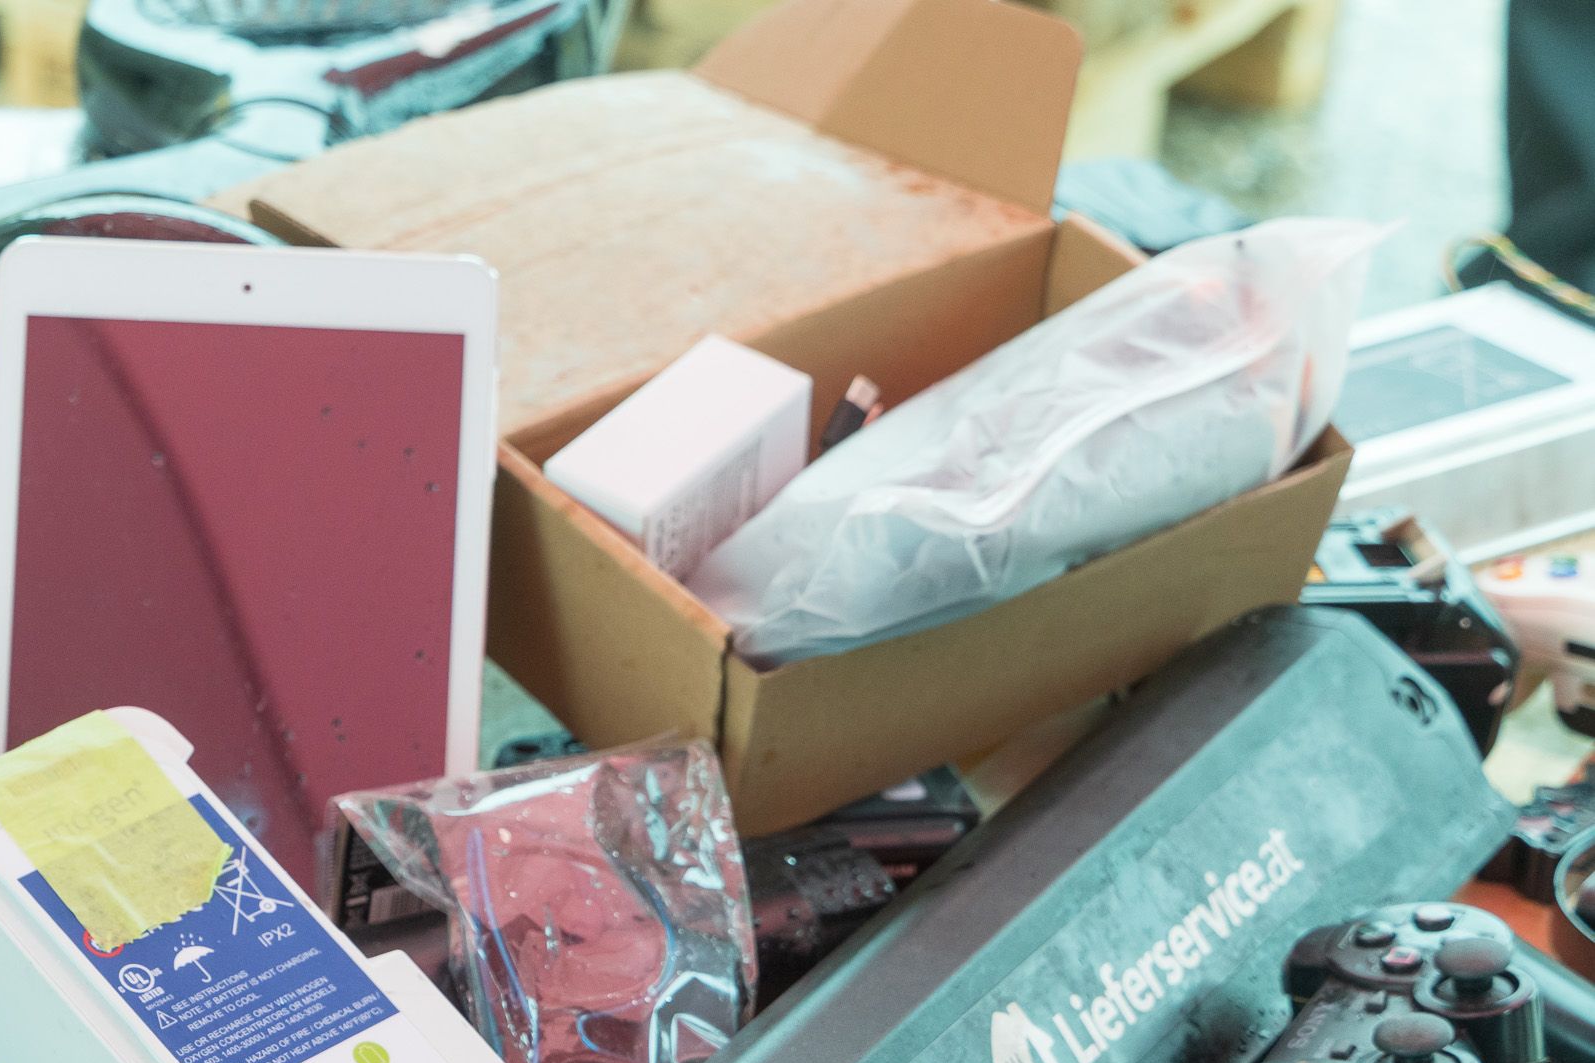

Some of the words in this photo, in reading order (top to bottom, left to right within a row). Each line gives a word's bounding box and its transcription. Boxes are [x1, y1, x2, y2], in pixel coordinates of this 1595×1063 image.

[257, 922, 296, 947] IPX2
[169, 999, 190, 1013] SEE
[187, 969, 250, 1004] INSTRUCTIONS
[202, 999, 215, 1009] IF
[211, 982, 250, 1004] BATTERY
[247, 977, 260, 986] IS
[257, 968, 277, 982] NOT
[174, 1042, 195, 1056] USE
[192, 1035, 210, 1048] OR
[206, 1013, 254, 1040] RECHARGE
[251, 1002, 276, 1018] ONLY
[272, 991, 298, 1007] WITH
[295, 975, 329, 996] INOGEN
[186, 1009, 224, 1031] REMOVE
[221, 1003, 237, 1014] TO
[216, 1007, 291, 1048] CONCENTRATORS
[287, 1000, 304, 1012] OR
[301, 983, 337, 1005] MODELS
[265, 1021, 286, 1035] AND
[277, 1036, 293, 1048] OF
[289, 1026, 312, 1041] FIRE
[312, 1005, 355, 1030] CHEMICAL
[351, 993, 377, 1010] BURN
[289, 1041, 313, 1057] HEAT
[309, 1027, 340, 1046] ABOVE
